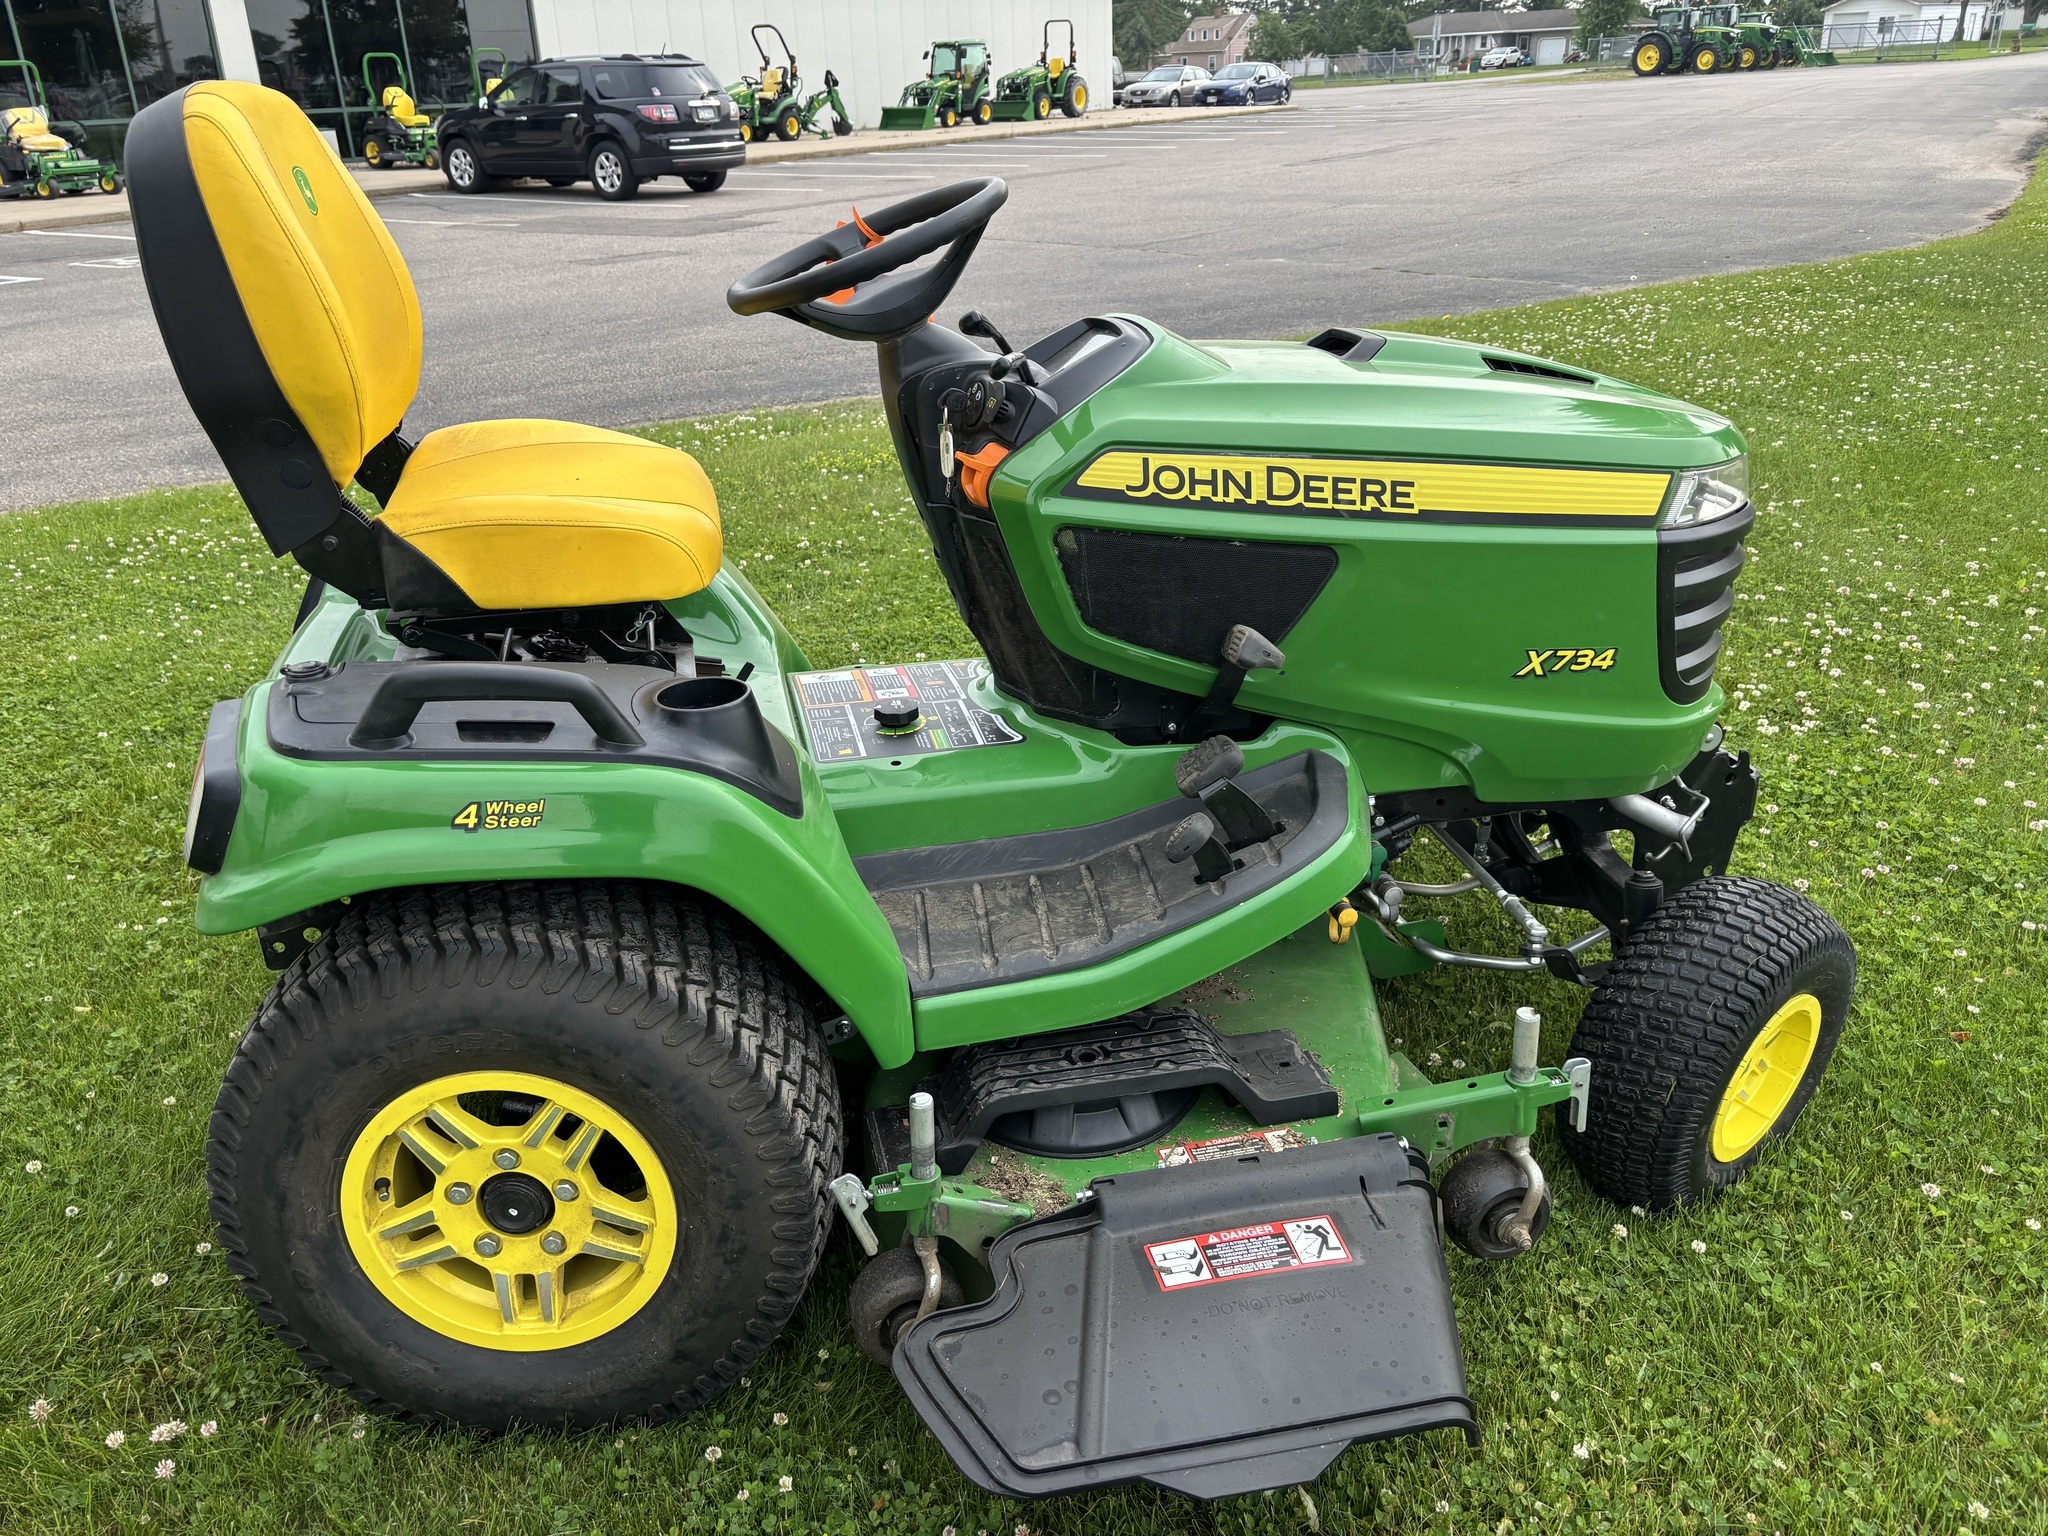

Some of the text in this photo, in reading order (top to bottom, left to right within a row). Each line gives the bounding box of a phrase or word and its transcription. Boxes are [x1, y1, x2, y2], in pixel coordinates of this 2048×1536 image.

[1125, 456, 1416, 510] JOHN DEERE
[1512, 647, 1618, 677] X734
[453, 798, 545, 830] 4 Wheel
[483, 814, 542, 830] Steer
[1220, 1225, 1275, 1241] DANGER
[1238, 1296, 1272, 1312] NOT
